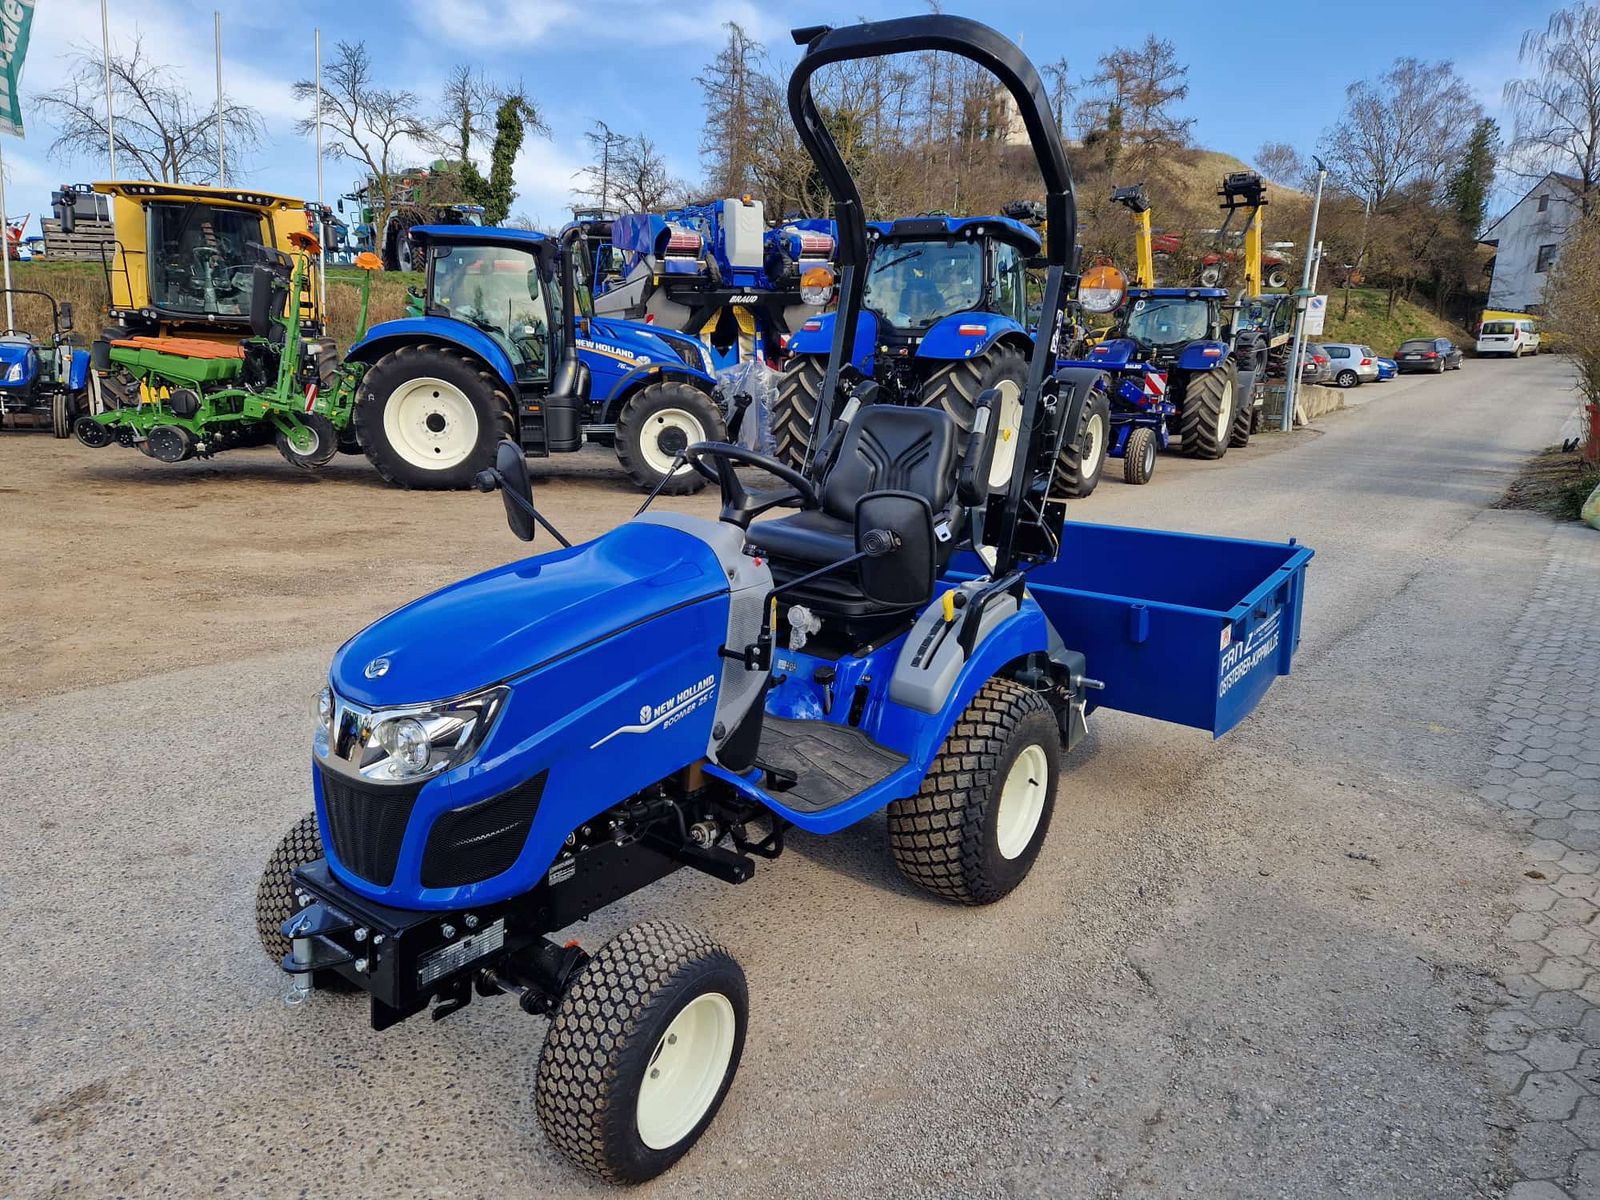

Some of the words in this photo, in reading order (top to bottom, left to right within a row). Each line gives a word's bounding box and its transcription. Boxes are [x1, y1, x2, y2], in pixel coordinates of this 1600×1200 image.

[728, 294, 759, 304] BRAUD
[575, 338, 594, 349] NEW
[595, 341, 635, 359] HOLLAND
[653, 697, 675, 719] NEW
[676, 674, 715, 705] HOLLAND
[663, 702, 697, 730] BOOMER
[698, 694, 708, 706] 25
[708, 690, 714, 699] C
